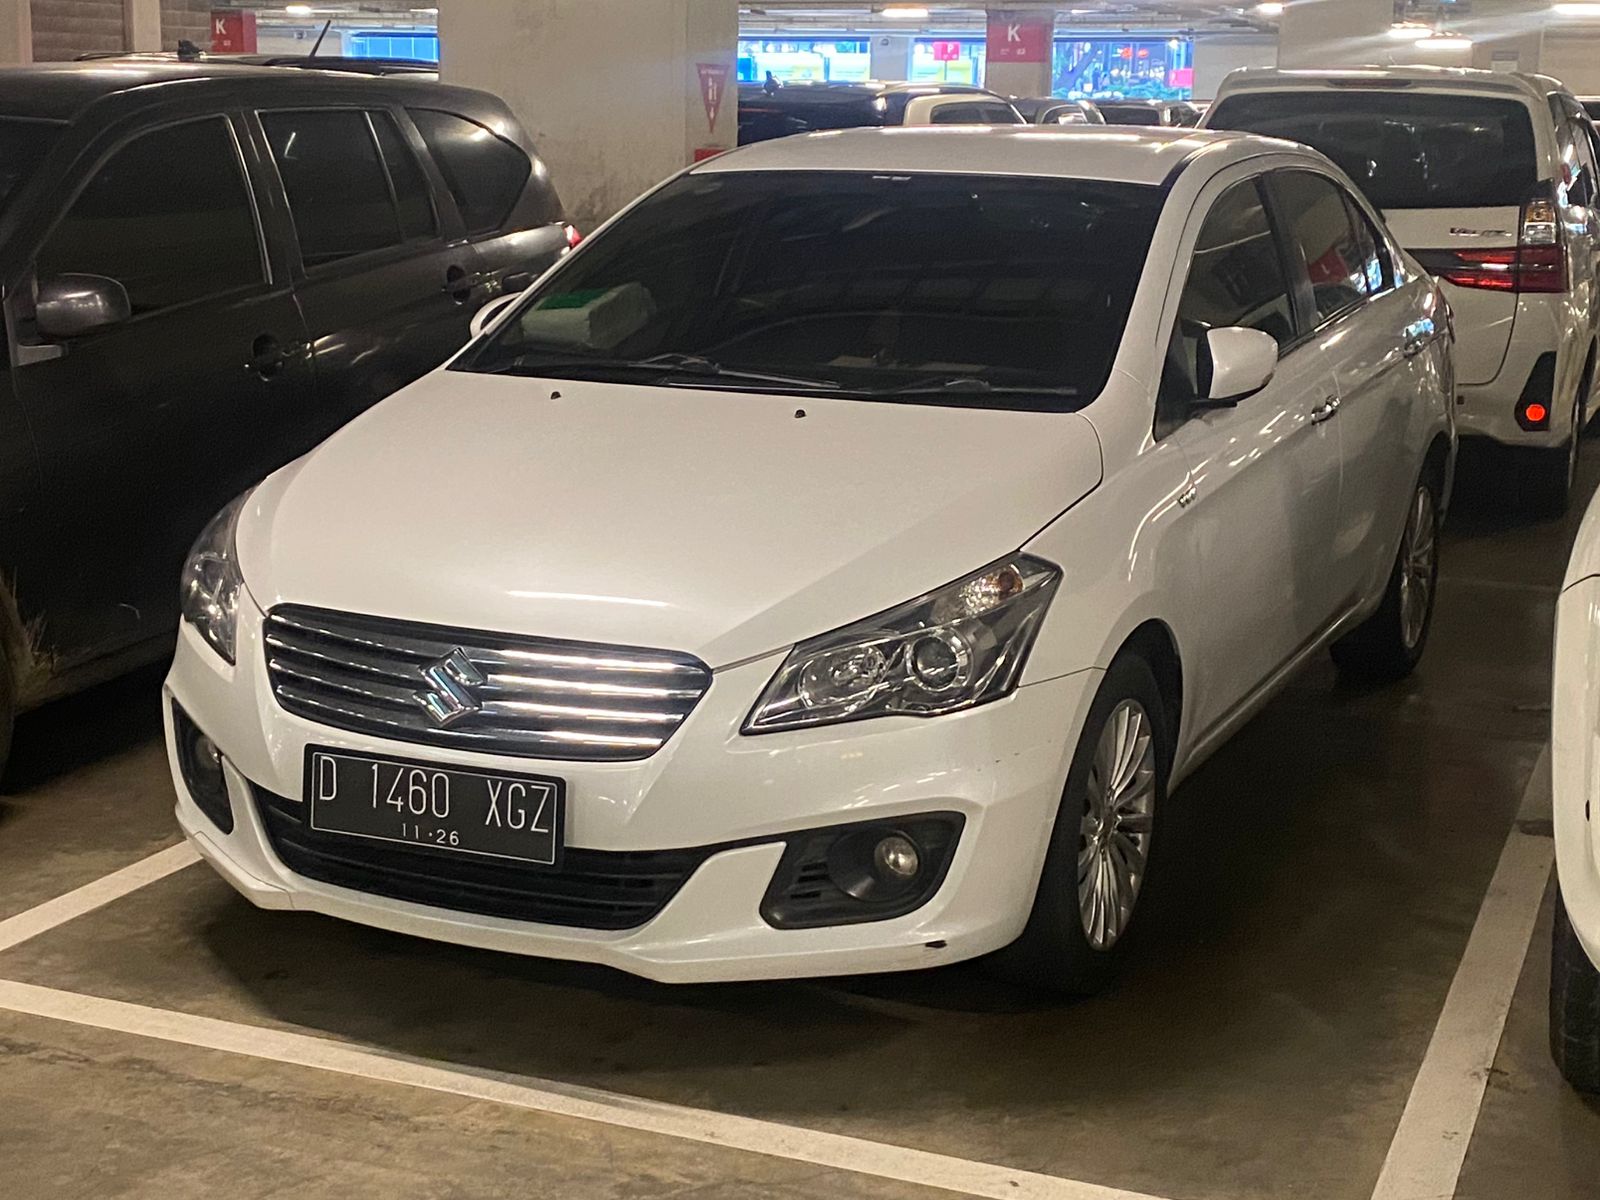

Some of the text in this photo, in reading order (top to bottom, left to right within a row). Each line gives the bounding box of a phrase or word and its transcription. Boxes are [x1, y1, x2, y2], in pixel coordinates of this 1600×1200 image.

[216, 18, 227, 34] K
[1008, 24, 1020, 42] K
[319, 756, 550, 833] D 1460 XGZ
